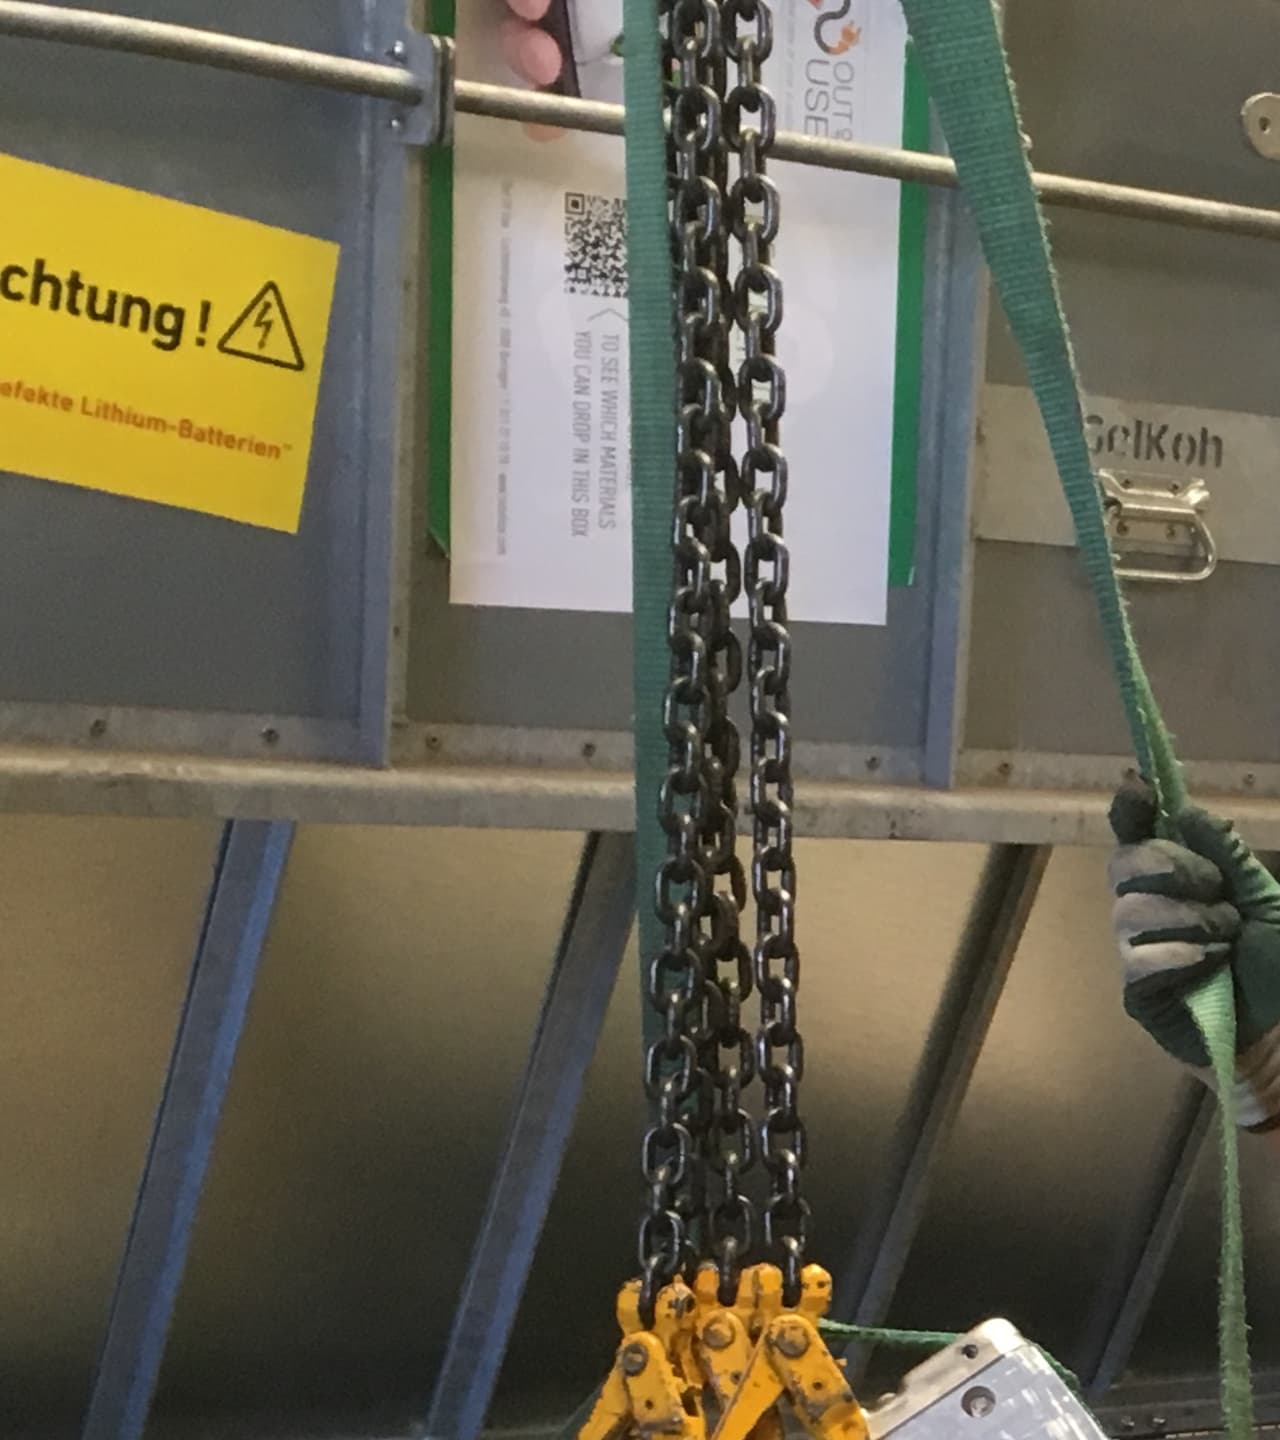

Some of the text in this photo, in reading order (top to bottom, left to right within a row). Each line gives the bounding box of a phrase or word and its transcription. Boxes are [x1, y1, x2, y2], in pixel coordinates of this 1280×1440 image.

[804, 59, 829, 137] USE
[832, 61, 854, 124] OUT
[570, 330, 593, 538] YOU CAN DROP IN THIS BOX
[597, 334, 620, 530] TO SEE WHICH MATERIALS
